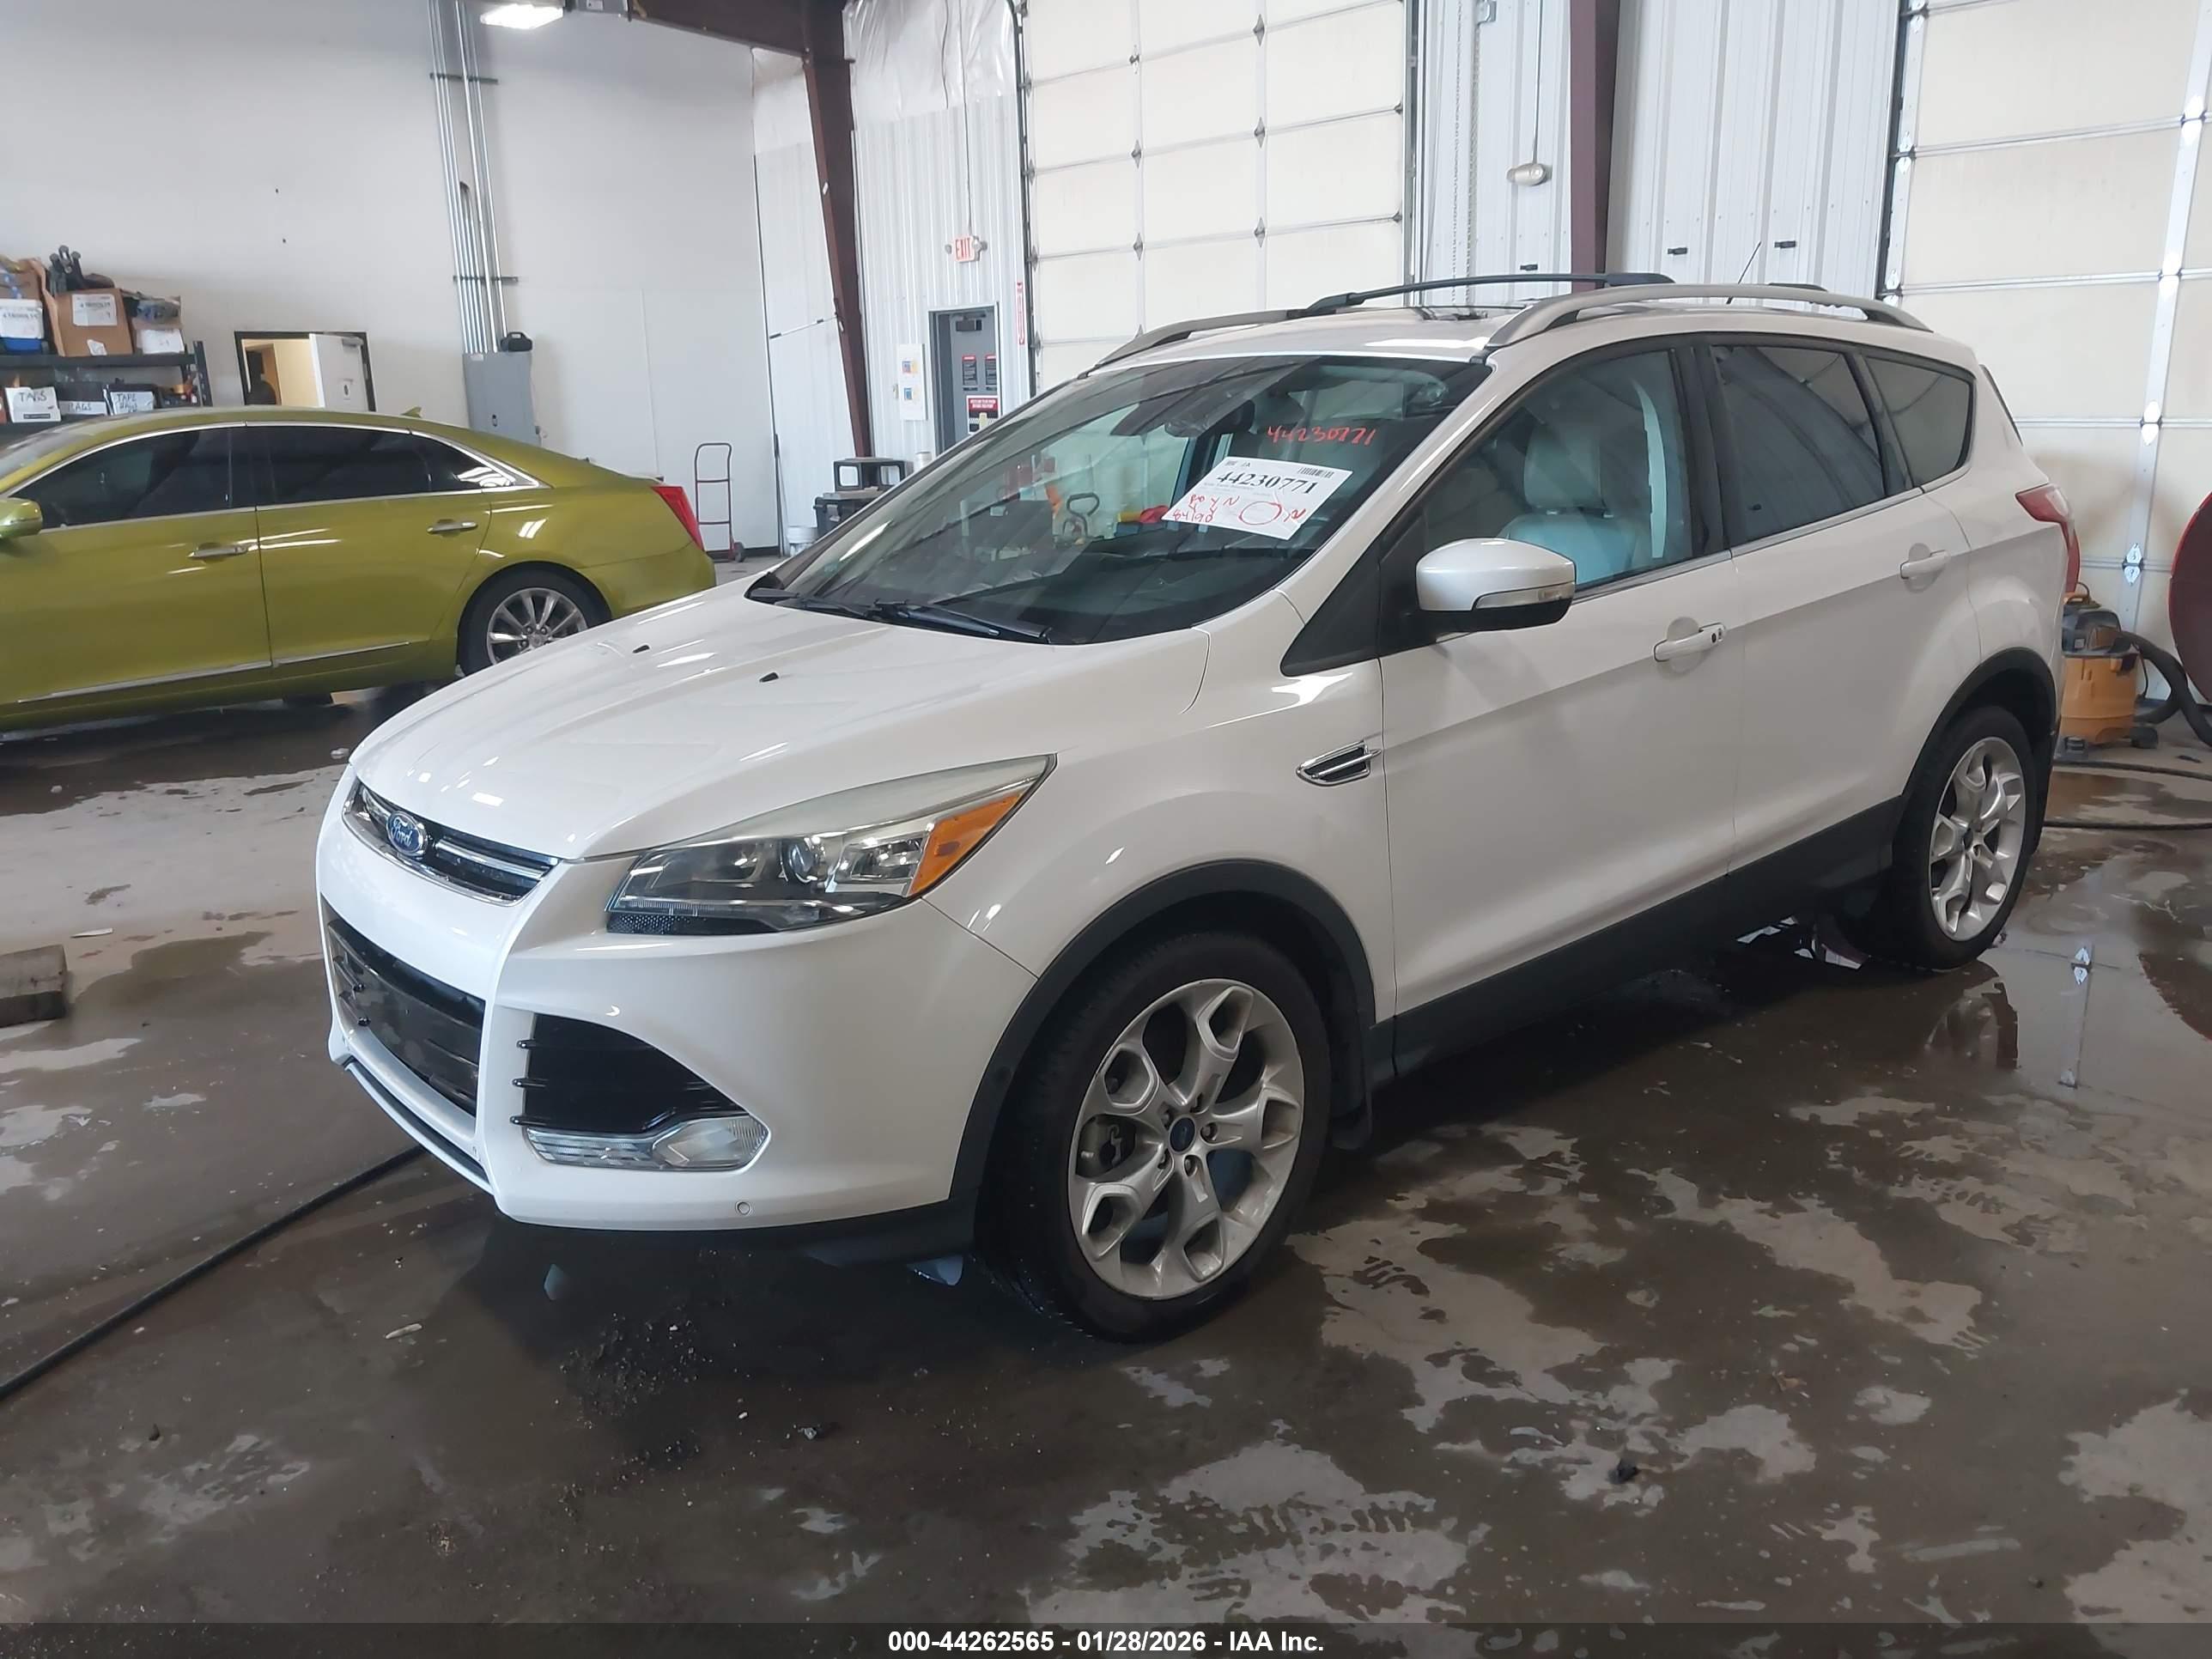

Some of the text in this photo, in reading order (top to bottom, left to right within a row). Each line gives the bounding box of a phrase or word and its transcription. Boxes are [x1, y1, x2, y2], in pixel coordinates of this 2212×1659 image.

[955, 238, 970, 259] EXIT
[1267, 425, 1376, 446] 44230771
[1216, 471, 1318, 495] 44230771
[391, 816, 413, 848] Ford
